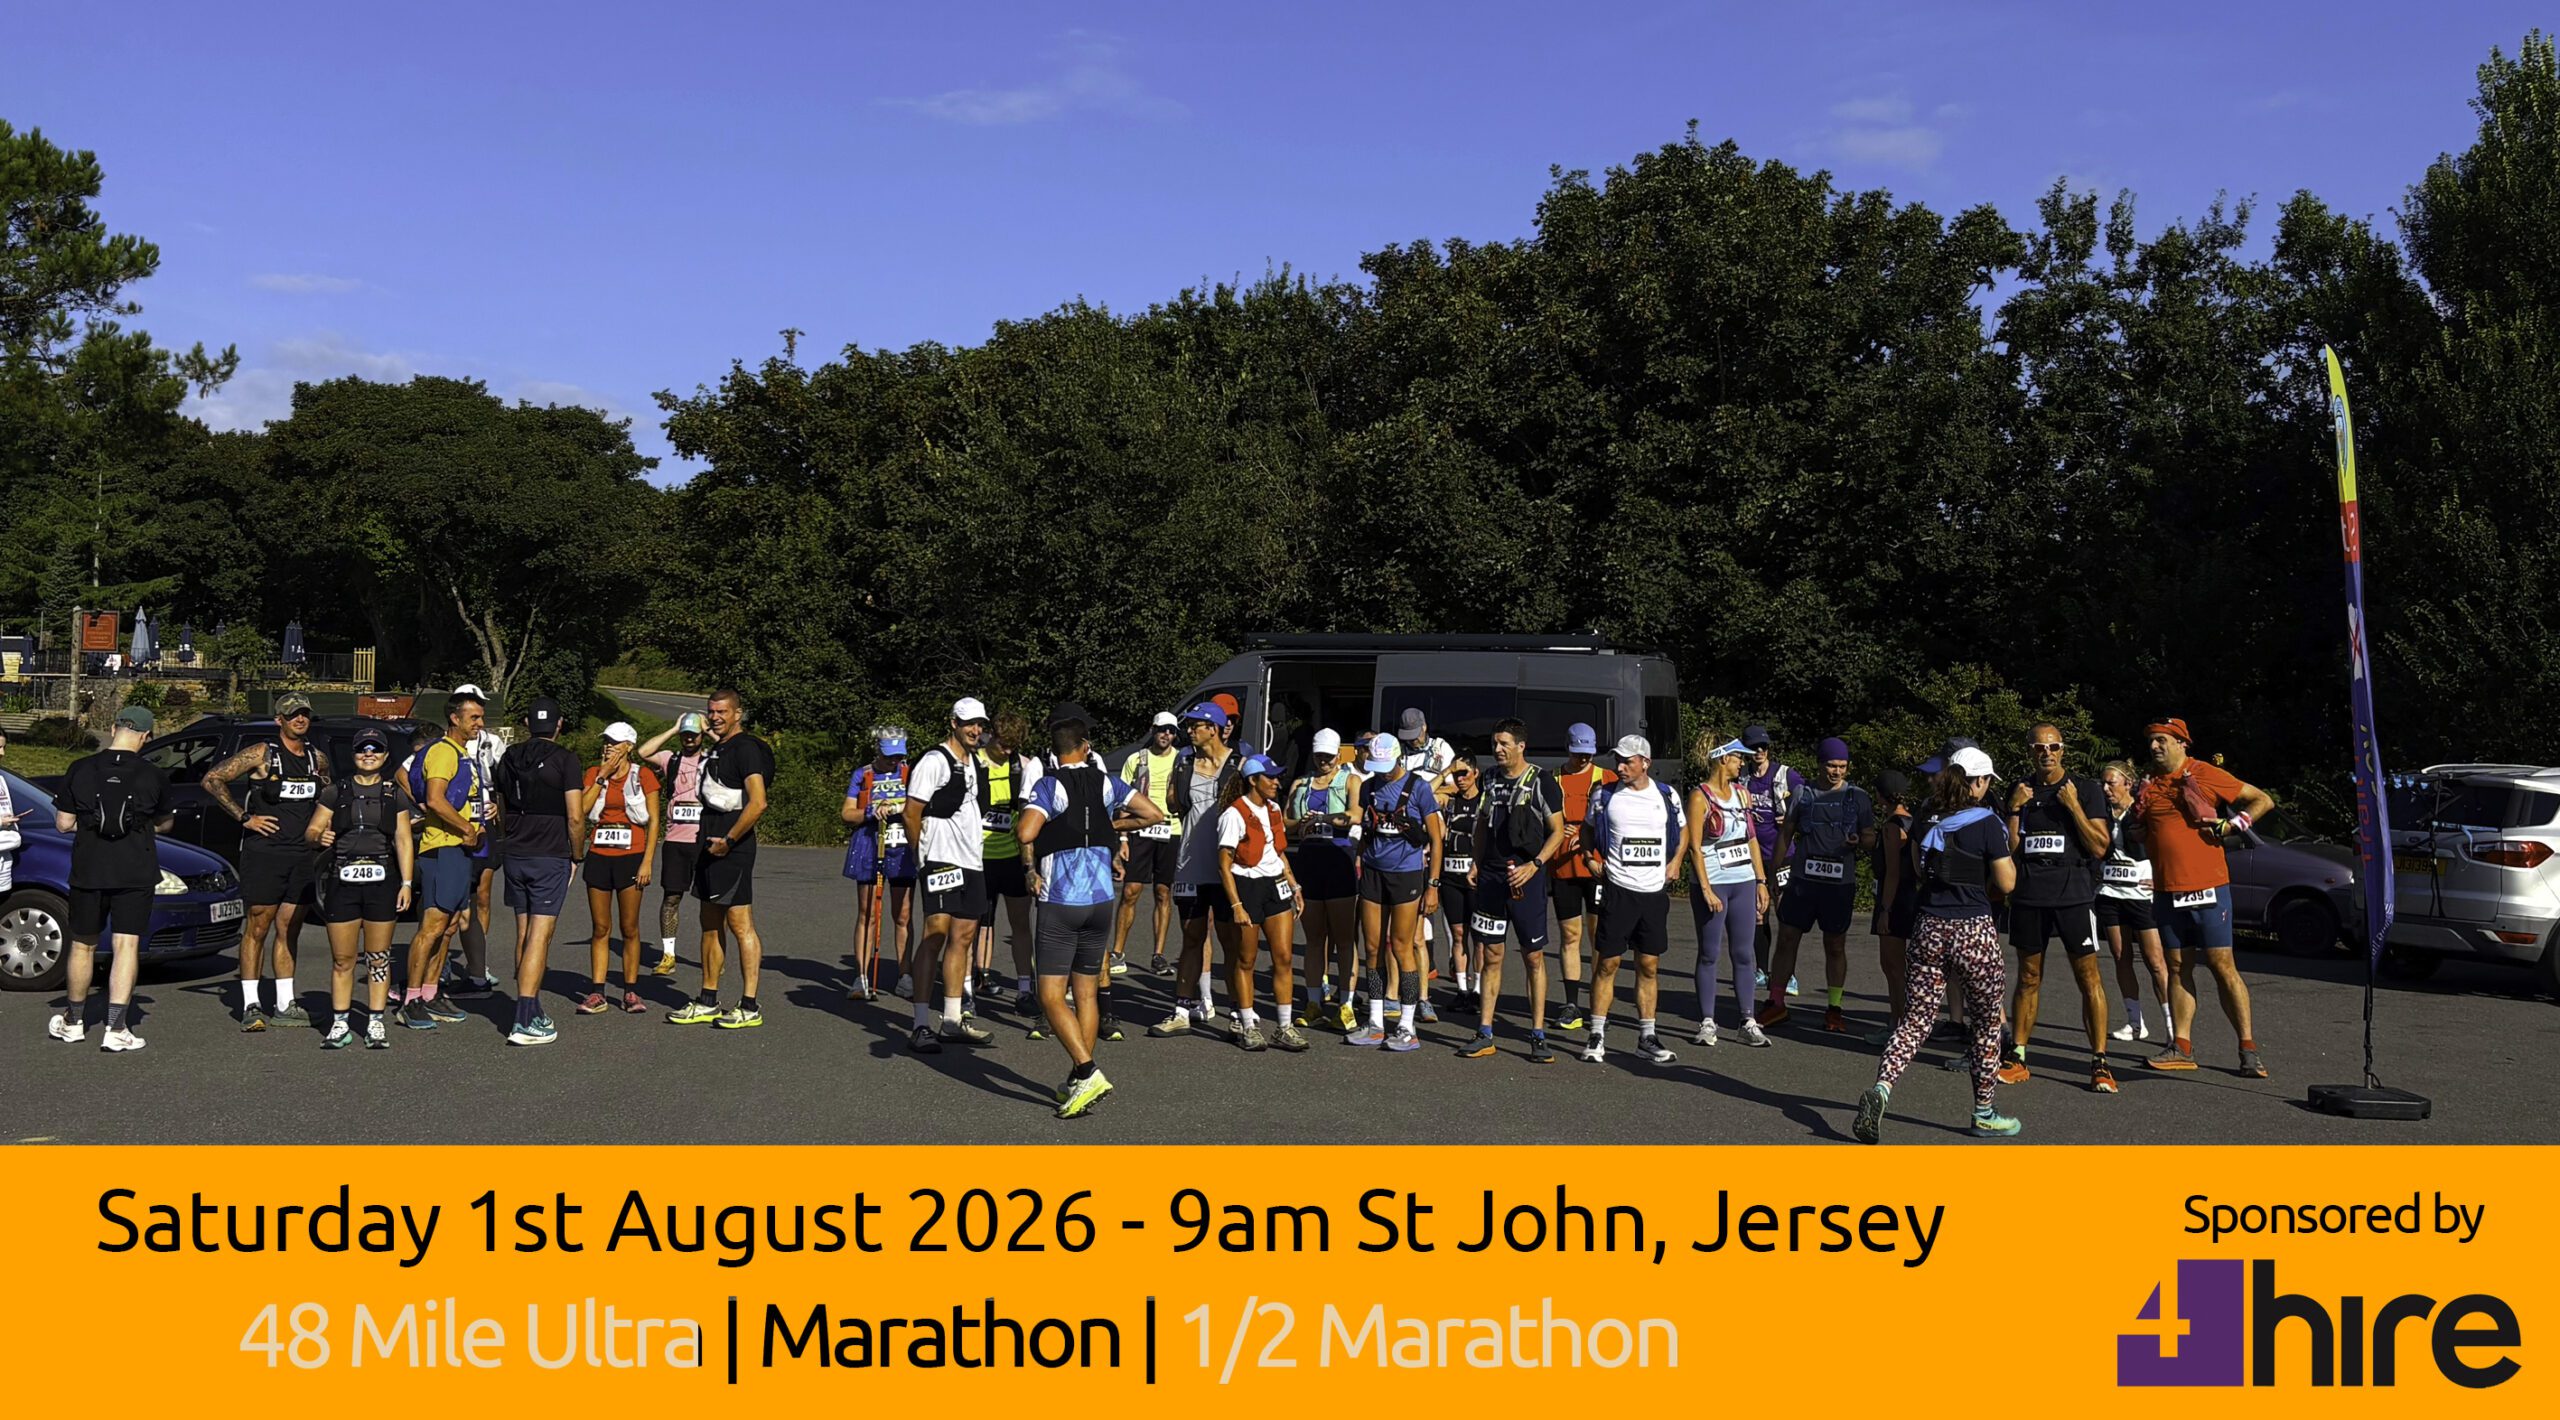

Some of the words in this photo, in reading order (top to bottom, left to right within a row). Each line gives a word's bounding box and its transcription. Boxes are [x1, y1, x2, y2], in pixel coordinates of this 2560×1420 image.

[289, 784, 305, 795] 216
[681, 808, 696, 817] 201
[604, 831, 620, 841] 241
[1148, 826, 1162, 835] 212
[2034, 837, 2053, 849] 209
[1633, 847, 1652, 857] 204
[1729, 847, 1743, 859] 119
[1452, 859, 1465, 869] 211
[1815, 863, 1833, 874] 240
[352, 867, 373, 879] 248
[2111, 867, 2129, 878] 250
[937, 873, 955, 886] 223
[2184, 890, 2204, 902] 239
[1478, 917, 1495, 931] 219
